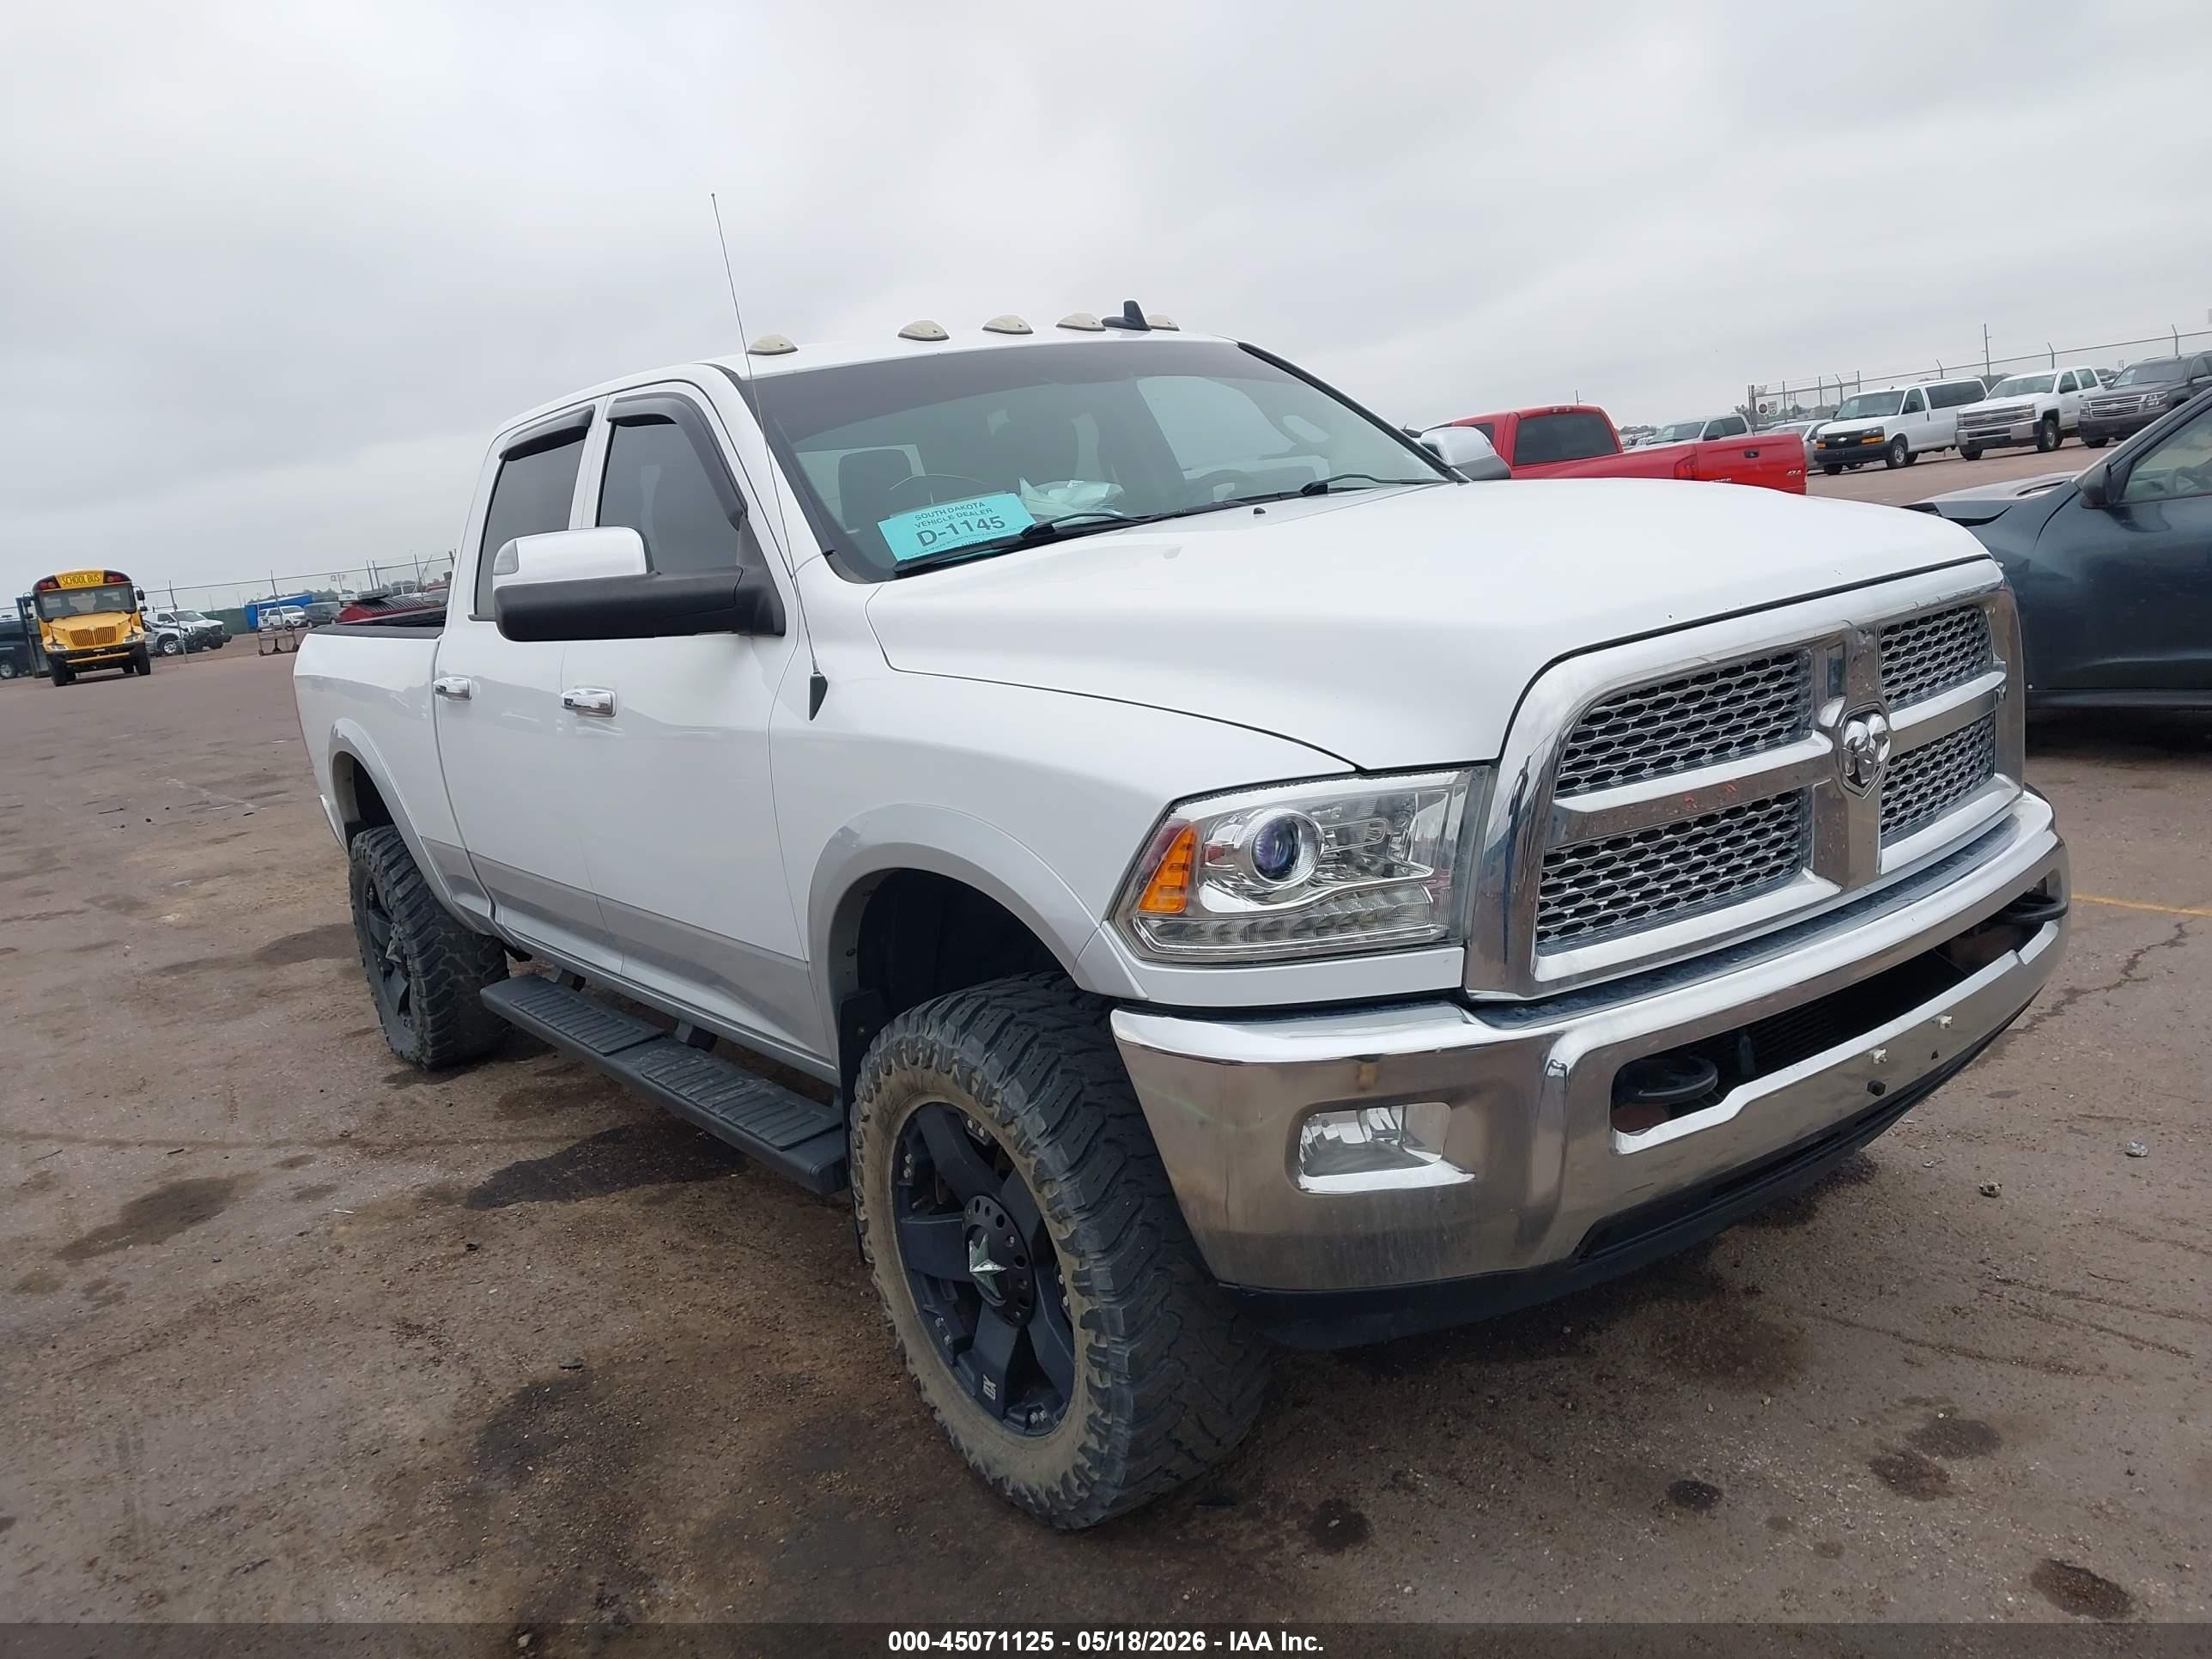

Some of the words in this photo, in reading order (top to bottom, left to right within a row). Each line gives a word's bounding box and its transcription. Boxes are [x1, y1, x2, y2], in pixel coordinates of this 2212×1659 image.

[915, 509, 946, 521] SOUTH
[947, 501, 986, 514] DAKOTA
[915, 514, 955, 528] VEHICLE
[954, 507, 994, 519] DEALER
[916, 515, 1006, 547] D-1145
[62, 575, 88, 585] SCHOOL
[88, 574, 100, 584] BUS
